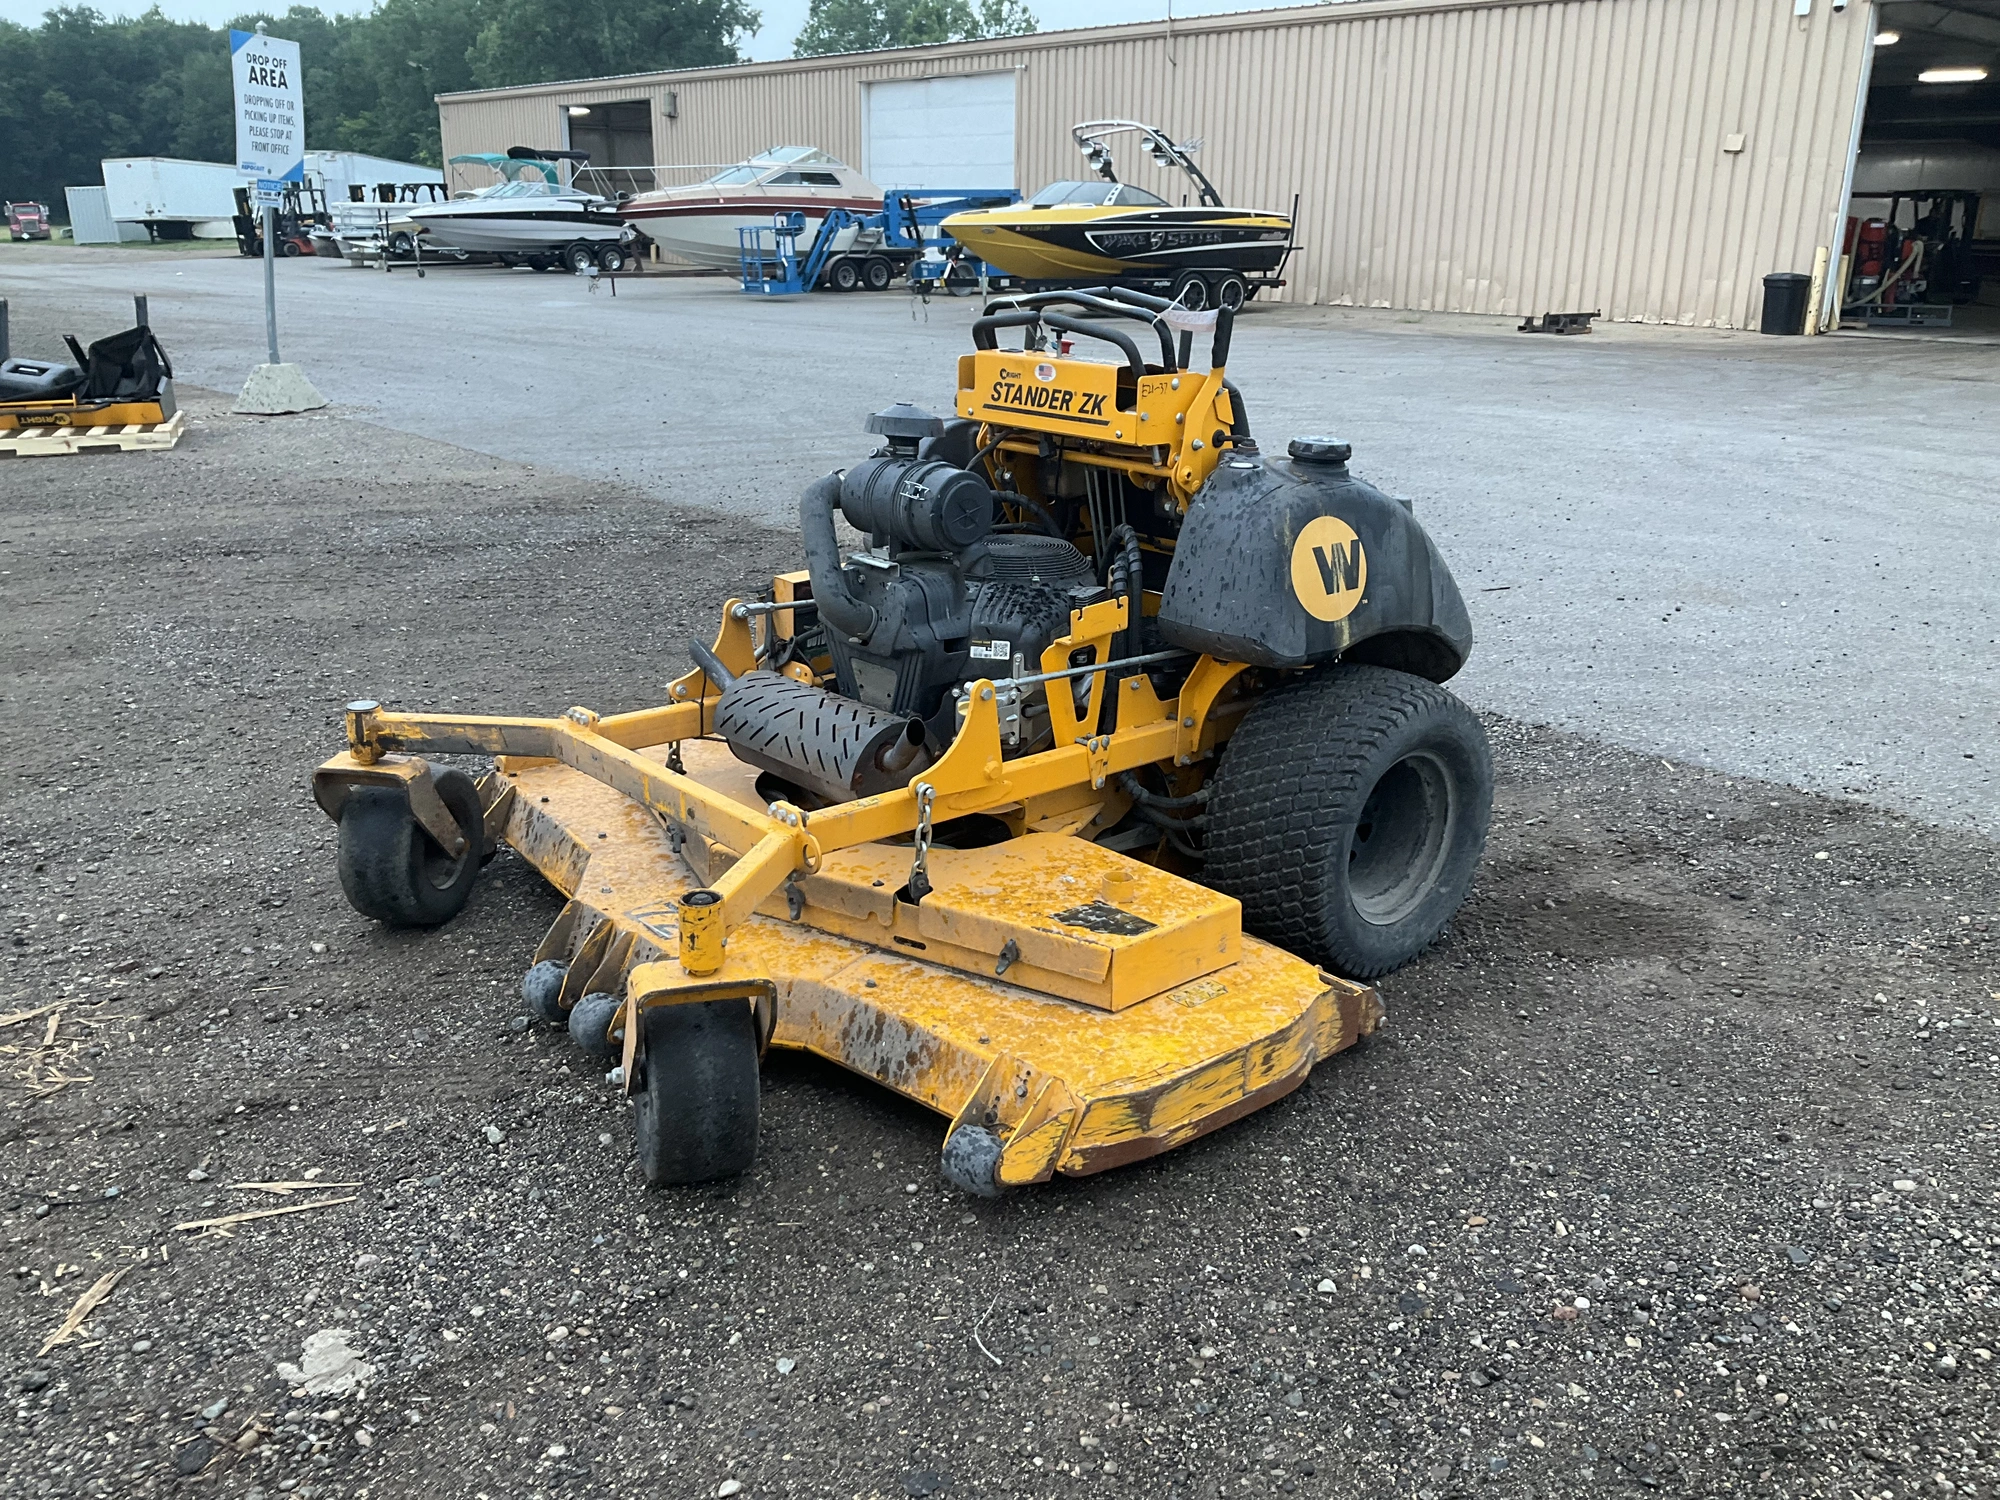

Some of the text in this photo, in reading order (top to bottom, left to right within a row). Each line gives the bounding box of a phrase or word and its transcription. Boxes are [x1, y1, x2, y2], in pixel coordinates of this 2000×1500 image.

[246, 53, 287, 69] DROP OFF
[248, 66, 288, 89] AREA
[244, 94, 295, 110] DROPPING OFF OR
[244, 110, 296, 127] PICKING UP ITEMS,
[249, 126, 293, 140] PLEASE STOP AT
[251, 141, 290, 155] FRONT OFFICE
[258, 181, 281, 190] NOTICE
[991, 381, 1108, 416] STANDER ZK
[1312, 539, 1360, 595] W
